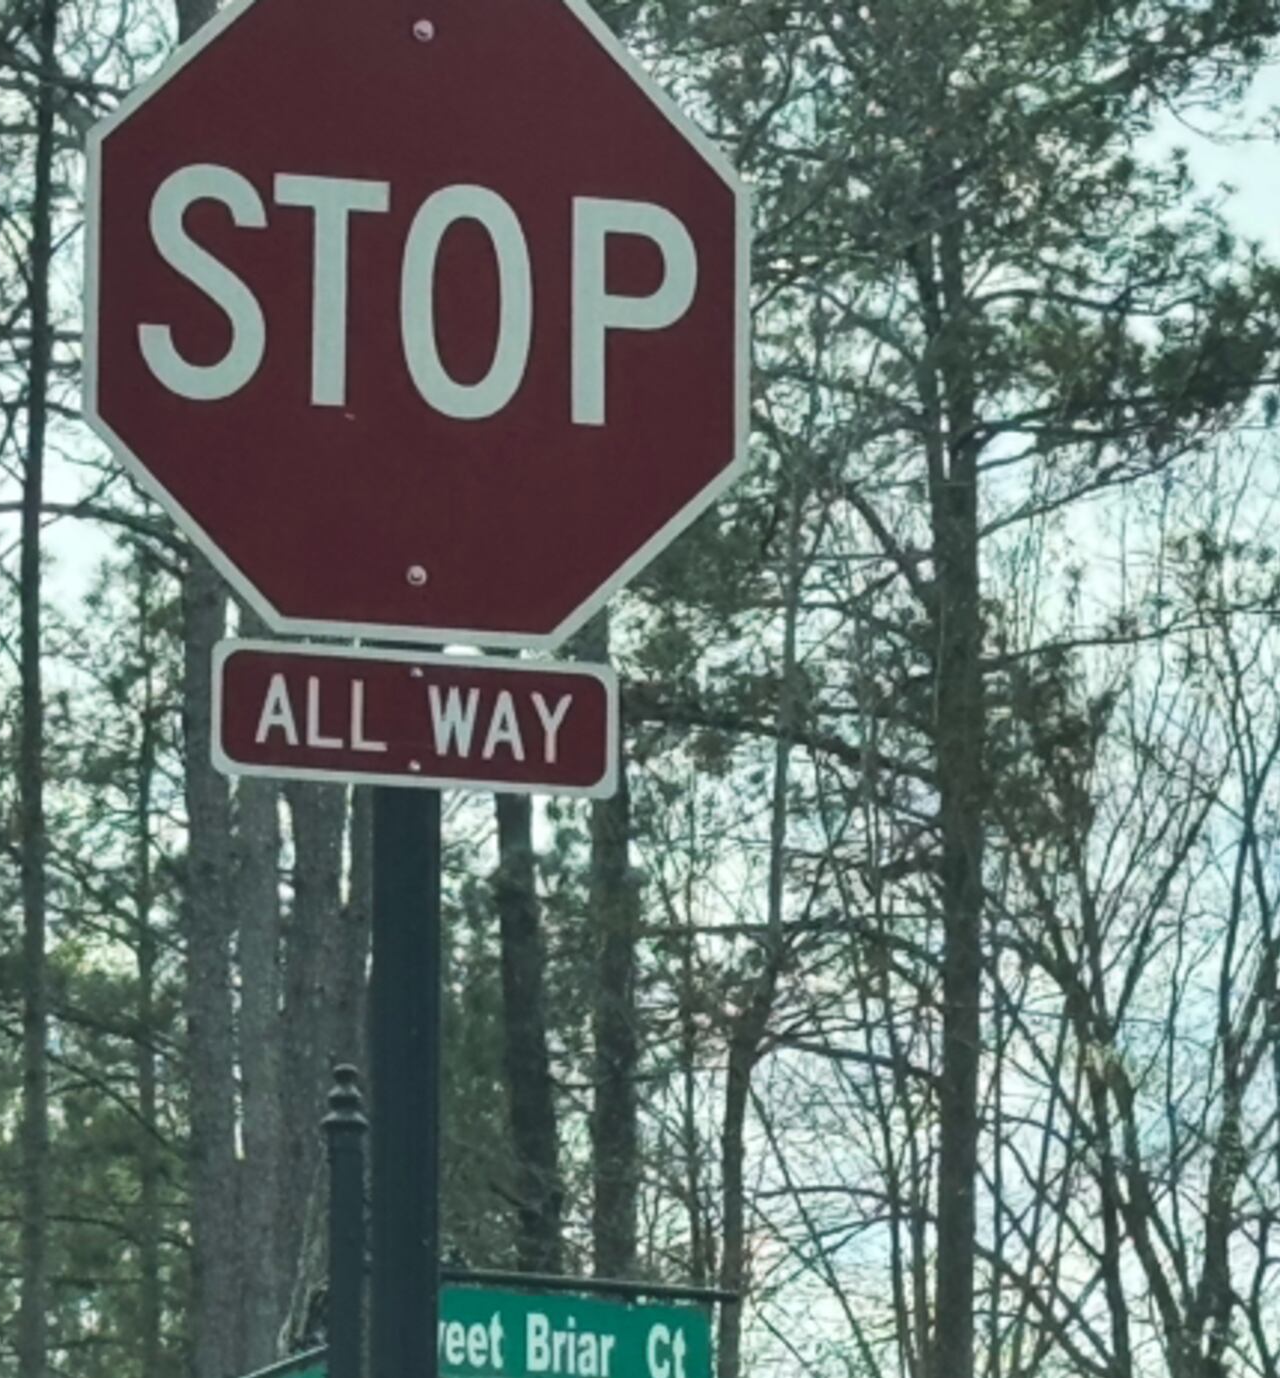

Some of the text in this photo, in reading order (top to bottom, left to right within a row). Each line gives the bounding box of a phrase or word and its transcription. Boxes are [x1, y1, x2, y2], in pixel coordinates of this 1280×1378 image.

[137, 162, 698, 426] STOP
[255, 672, 573, 764] ALL WAY
[438, 1311, 504, 1369] eet
[525, 1312, 616, 1378] Briar
